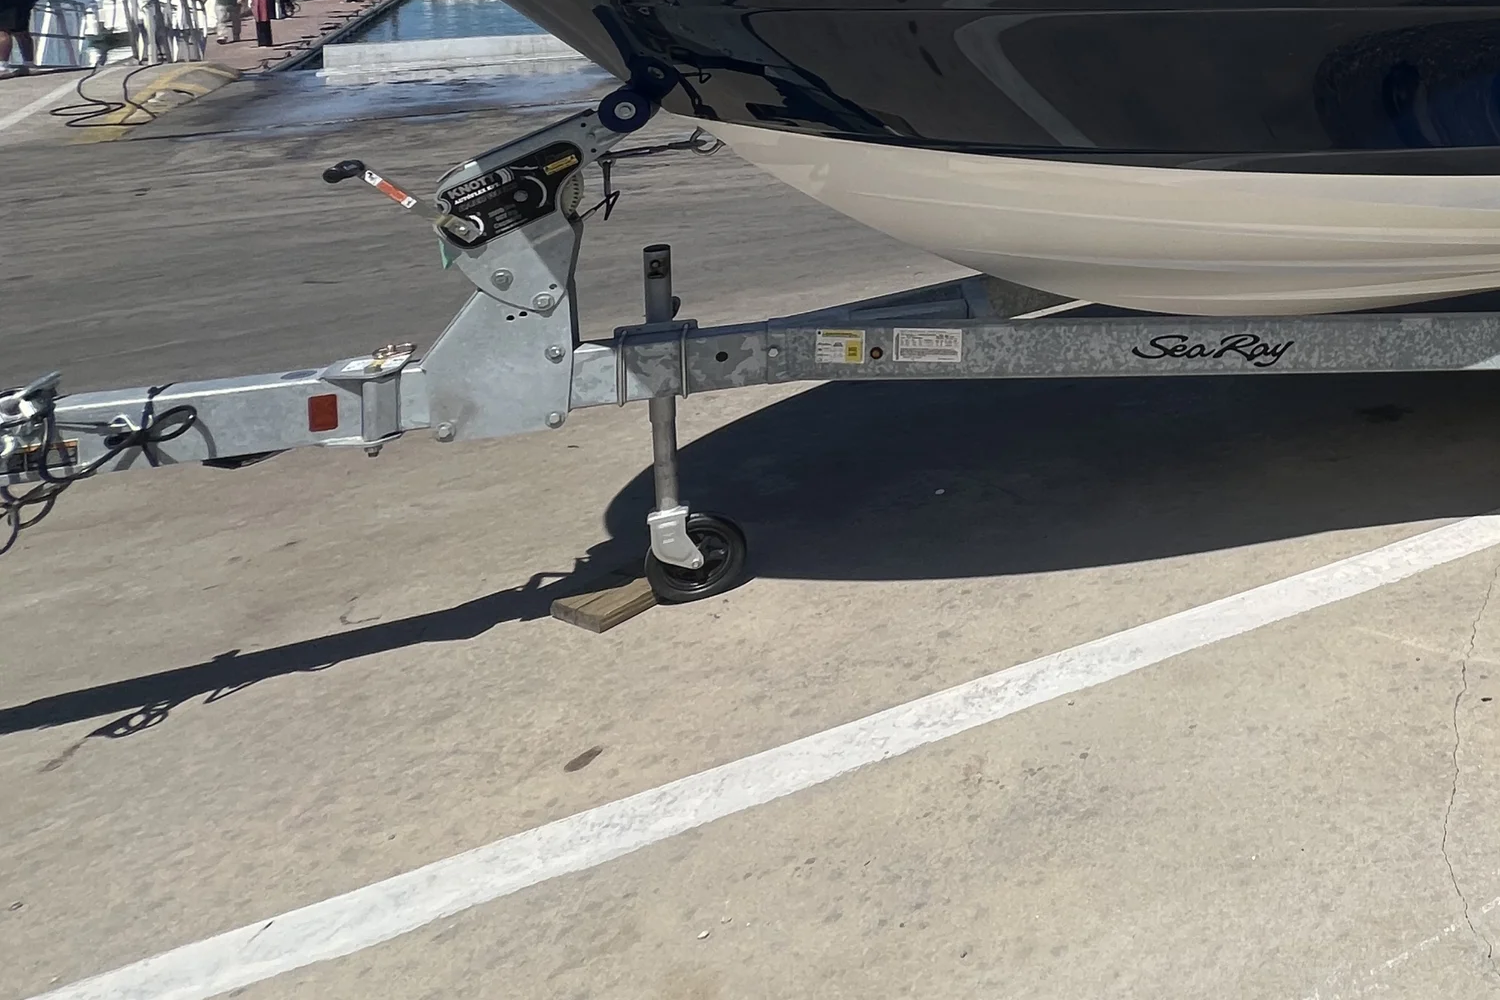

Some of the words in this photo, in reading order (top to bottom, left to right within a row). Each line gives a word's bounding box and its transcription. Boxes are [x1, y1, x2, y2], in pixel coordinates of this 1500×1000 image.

[447, 172, 496, 200] KNOTT
[1131, 334, 1216, 360] Sea
[1212, 333, 1295, 367] Ray
